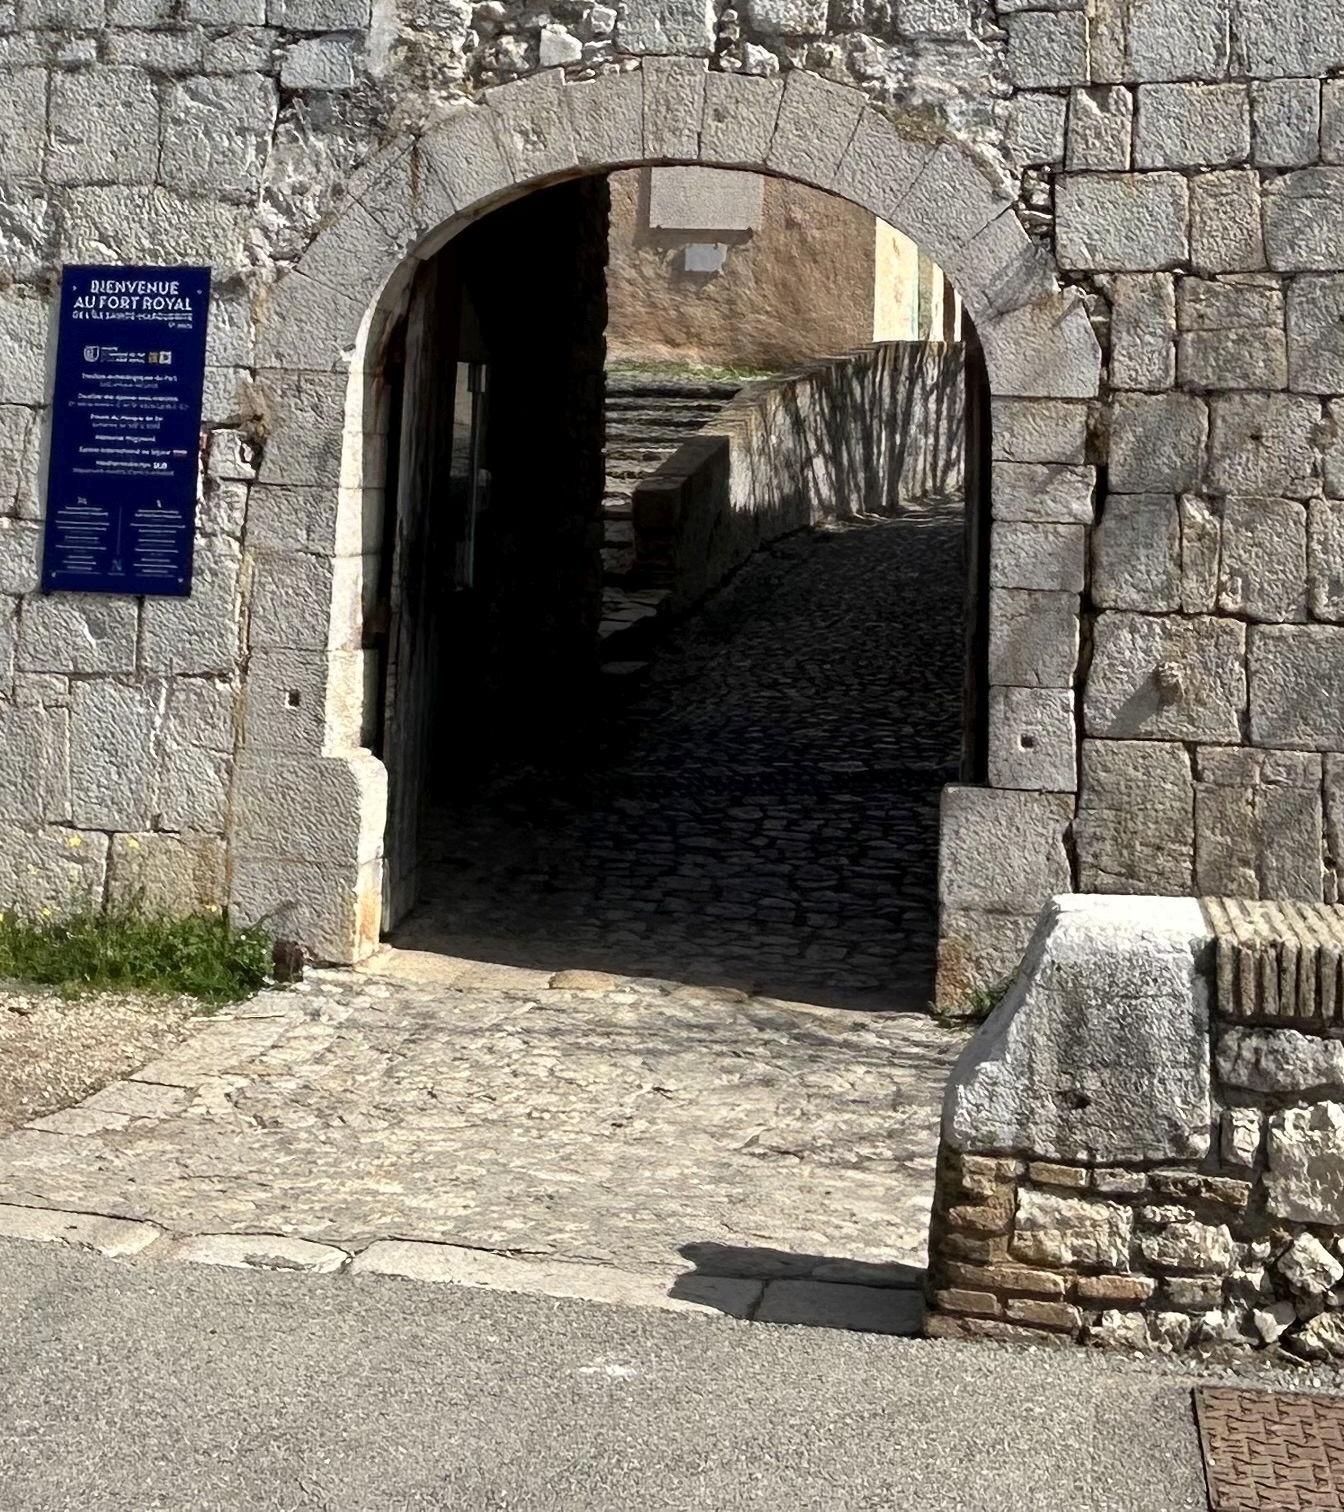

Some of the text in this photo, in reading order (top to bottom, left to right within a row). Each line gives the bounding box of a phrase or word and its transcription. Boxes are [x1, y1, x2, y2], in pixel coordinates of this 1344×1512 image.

[90, 280, 179, 295] BIENVENUE
[73, 295, 192, 310] AU FORT ROYAL
